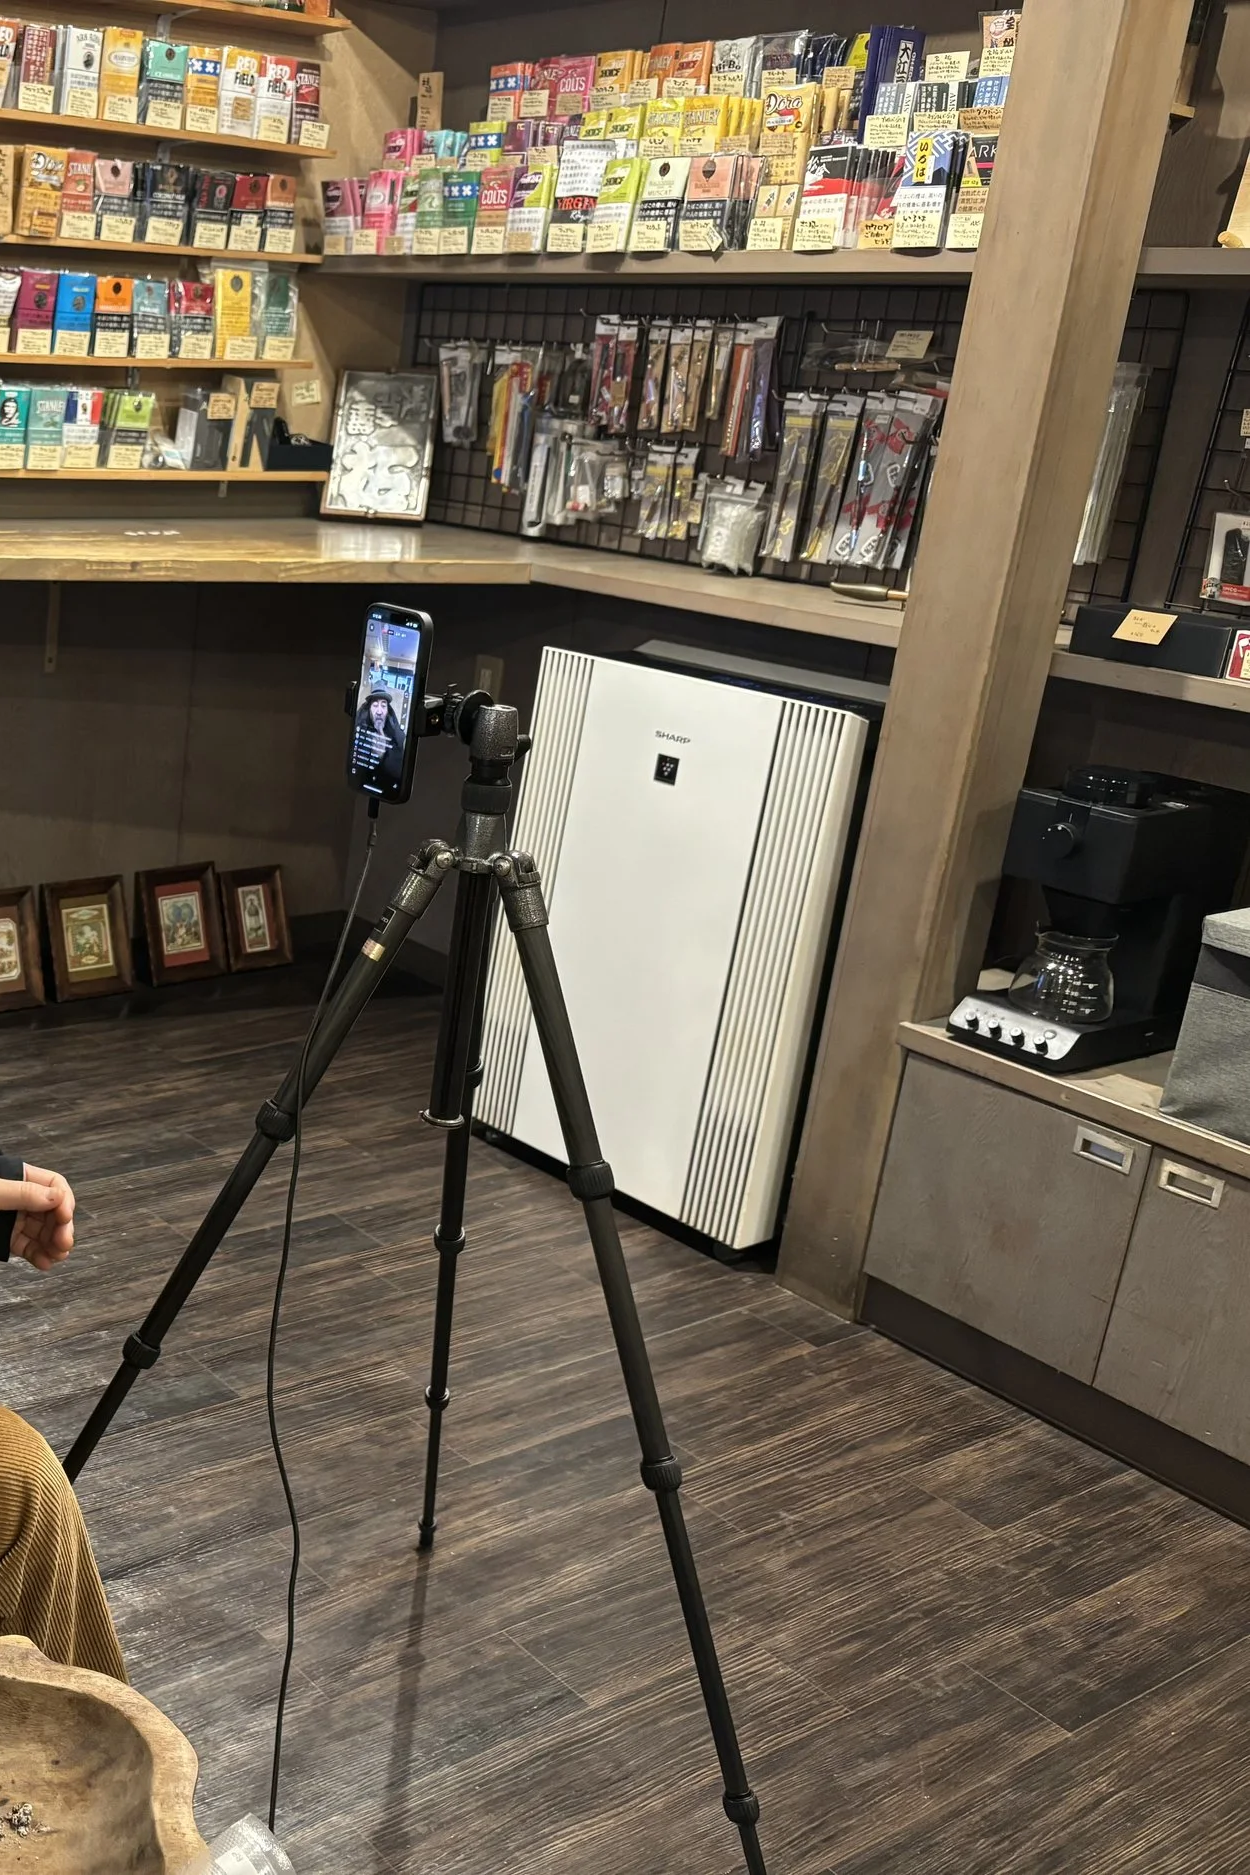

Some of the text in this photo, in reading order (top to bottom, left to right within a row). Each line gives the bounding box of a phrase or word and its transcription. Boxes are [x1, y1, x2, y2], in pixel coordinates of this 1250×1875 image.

[236, 56, 257, 72] RED
[268, 63, 291, 79] RED
[234, 71, 256, 87] FIELD
[559, 76, 586, 92] COLTS
[266, 80, 289, 95] FIELD
[765, 92, 804, 115] Dora
[916, 142, 929, 178] いろは
[481, 189, 508, 205] COLTS
[654, 730, 691, 744] SHARP
